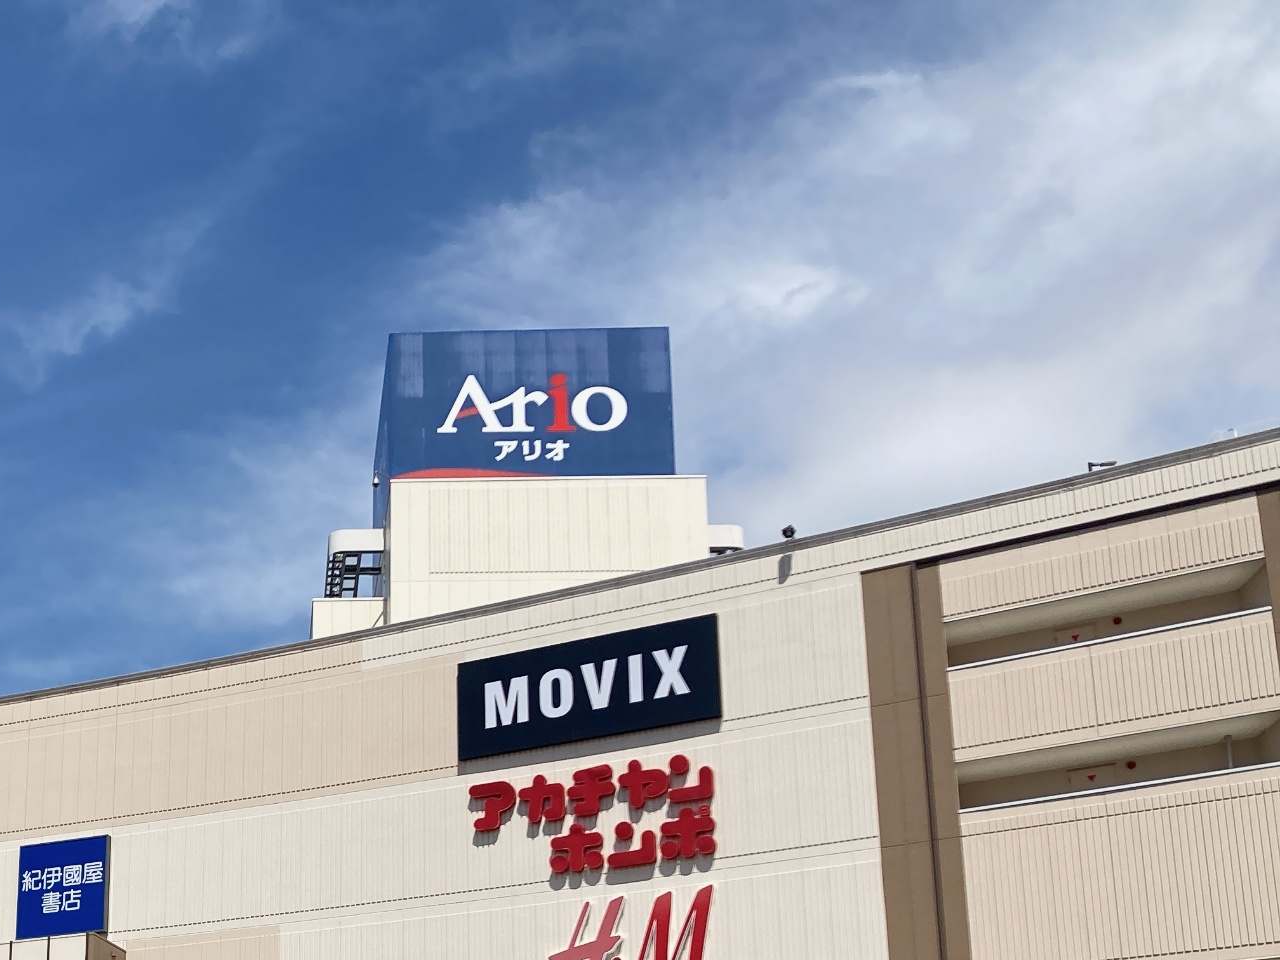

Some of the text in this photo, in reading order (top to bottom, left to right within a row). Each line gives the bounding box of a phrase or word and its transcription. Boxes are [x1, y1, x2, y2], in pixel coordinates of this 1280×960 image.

[436, 373, 628, 433] Ario
[493, 439, 570, 461] アリオ
[484, 644, 691, 729] MOVIX
[469, 755, 714, 831] アカチャン
[550, 805, 716, 873] ホンポ
[21, 861, 104, 892] 紀伊國屋
[41, 888, 82, 914] 書店
